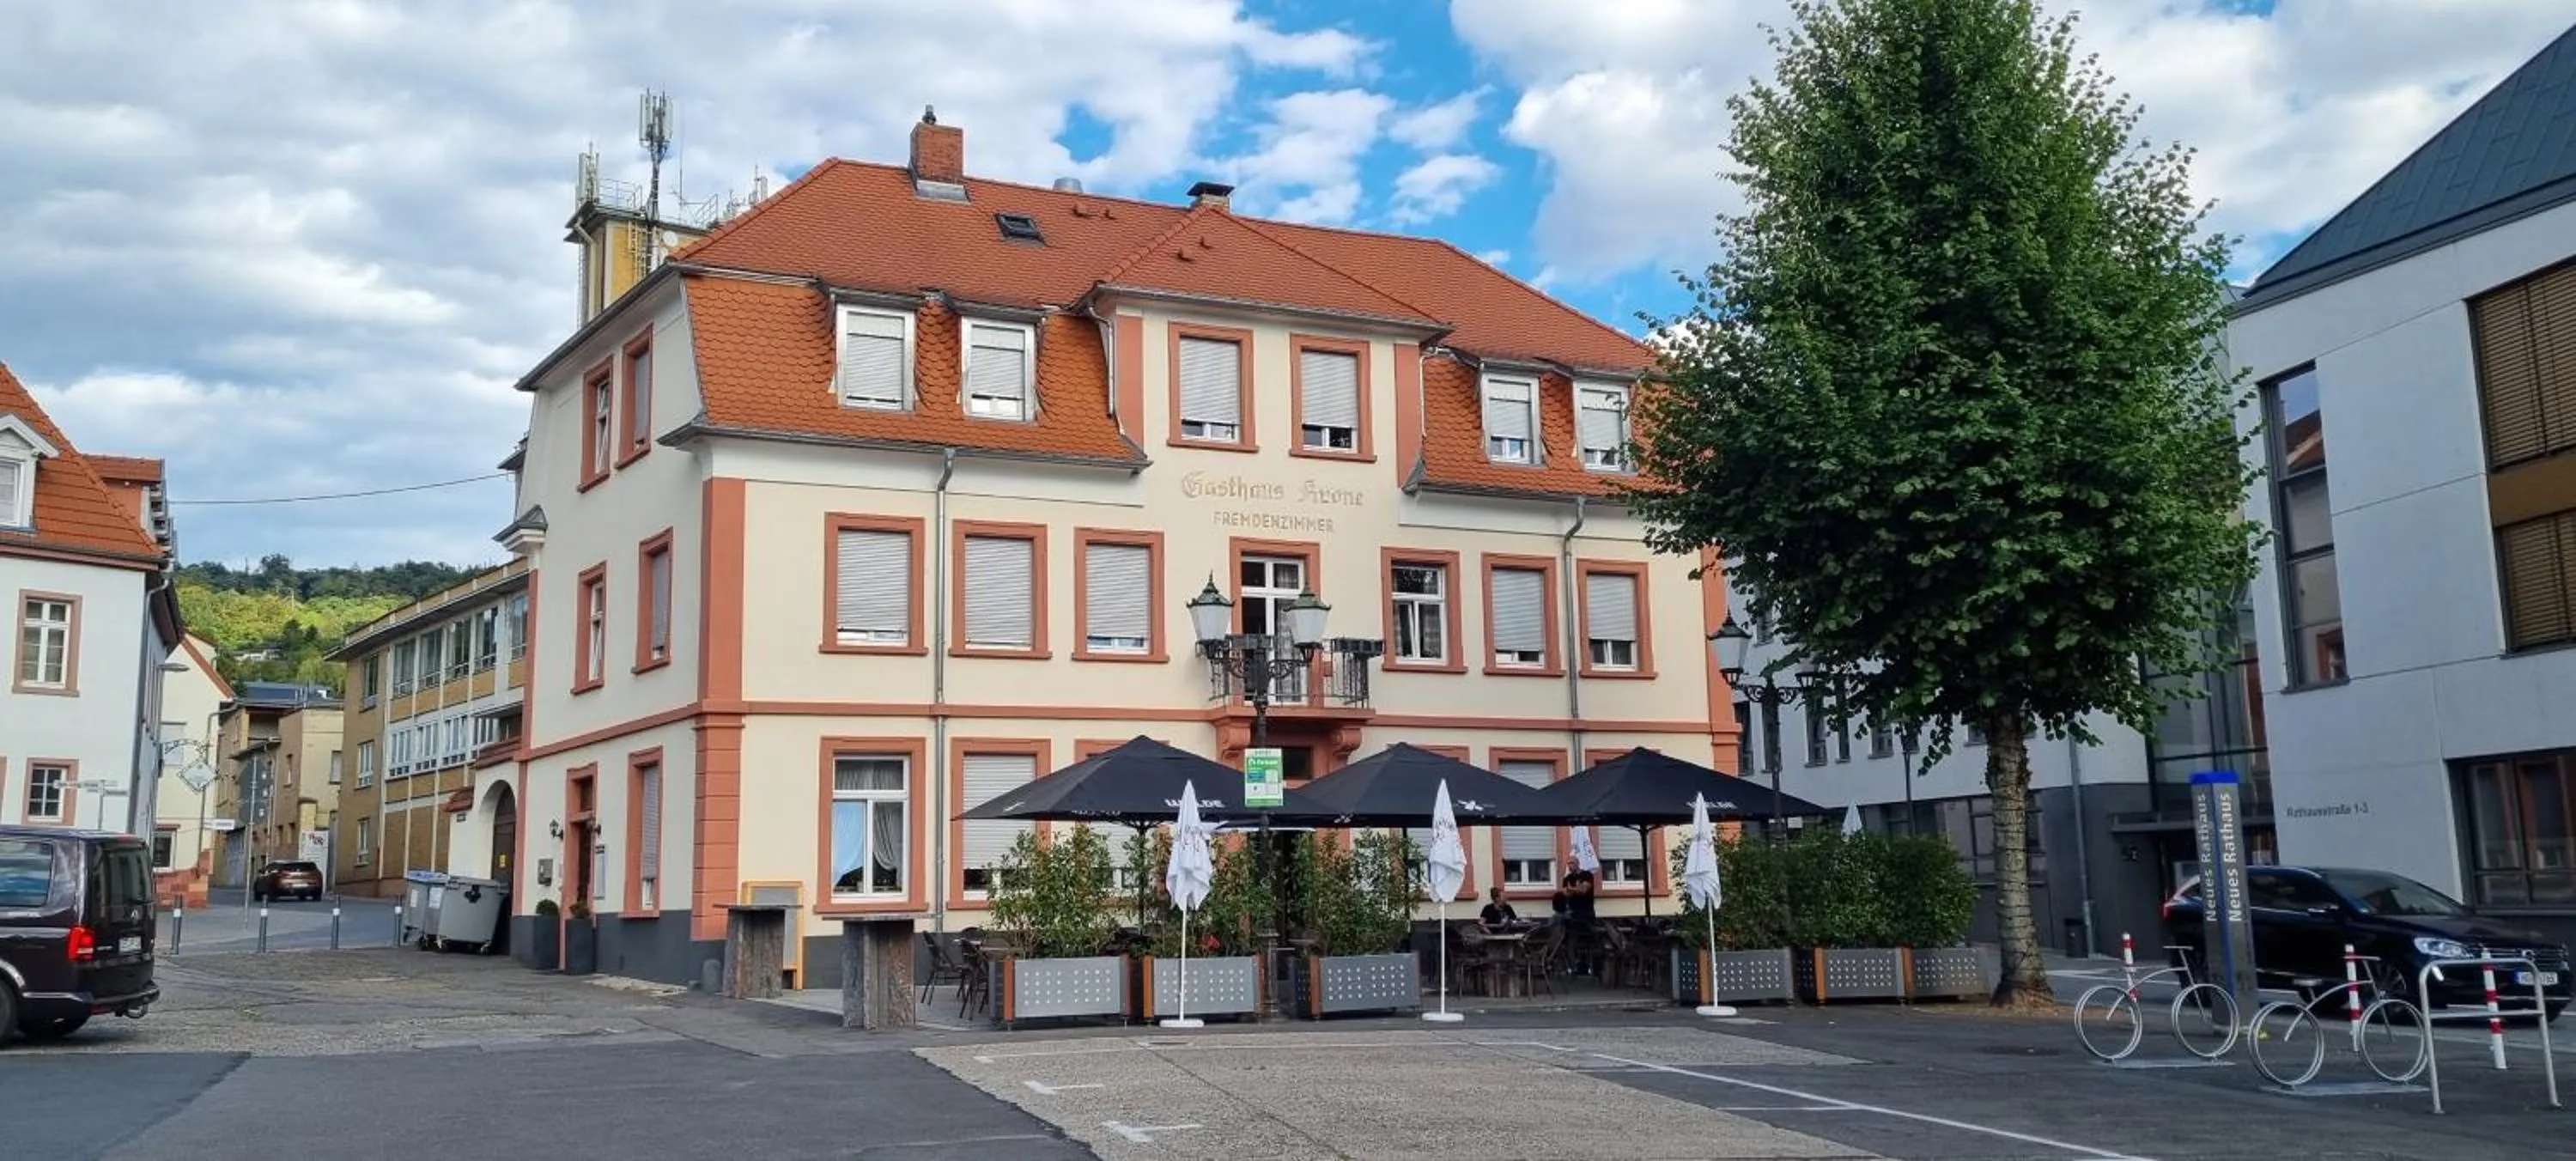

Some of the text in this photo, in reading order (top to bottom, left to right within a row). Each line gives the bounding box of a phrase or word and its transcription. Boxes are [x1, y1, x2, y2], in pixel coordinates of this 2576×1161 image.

[1181, 471, 1364, 507] Gasthaus Krone
[1213, 511, 1334, 532] FREMDENZIMMER
[2197, 793, 2217, 922] Neues Rathaus
[2220, 793, 2242, 922] Neues Rathaus
